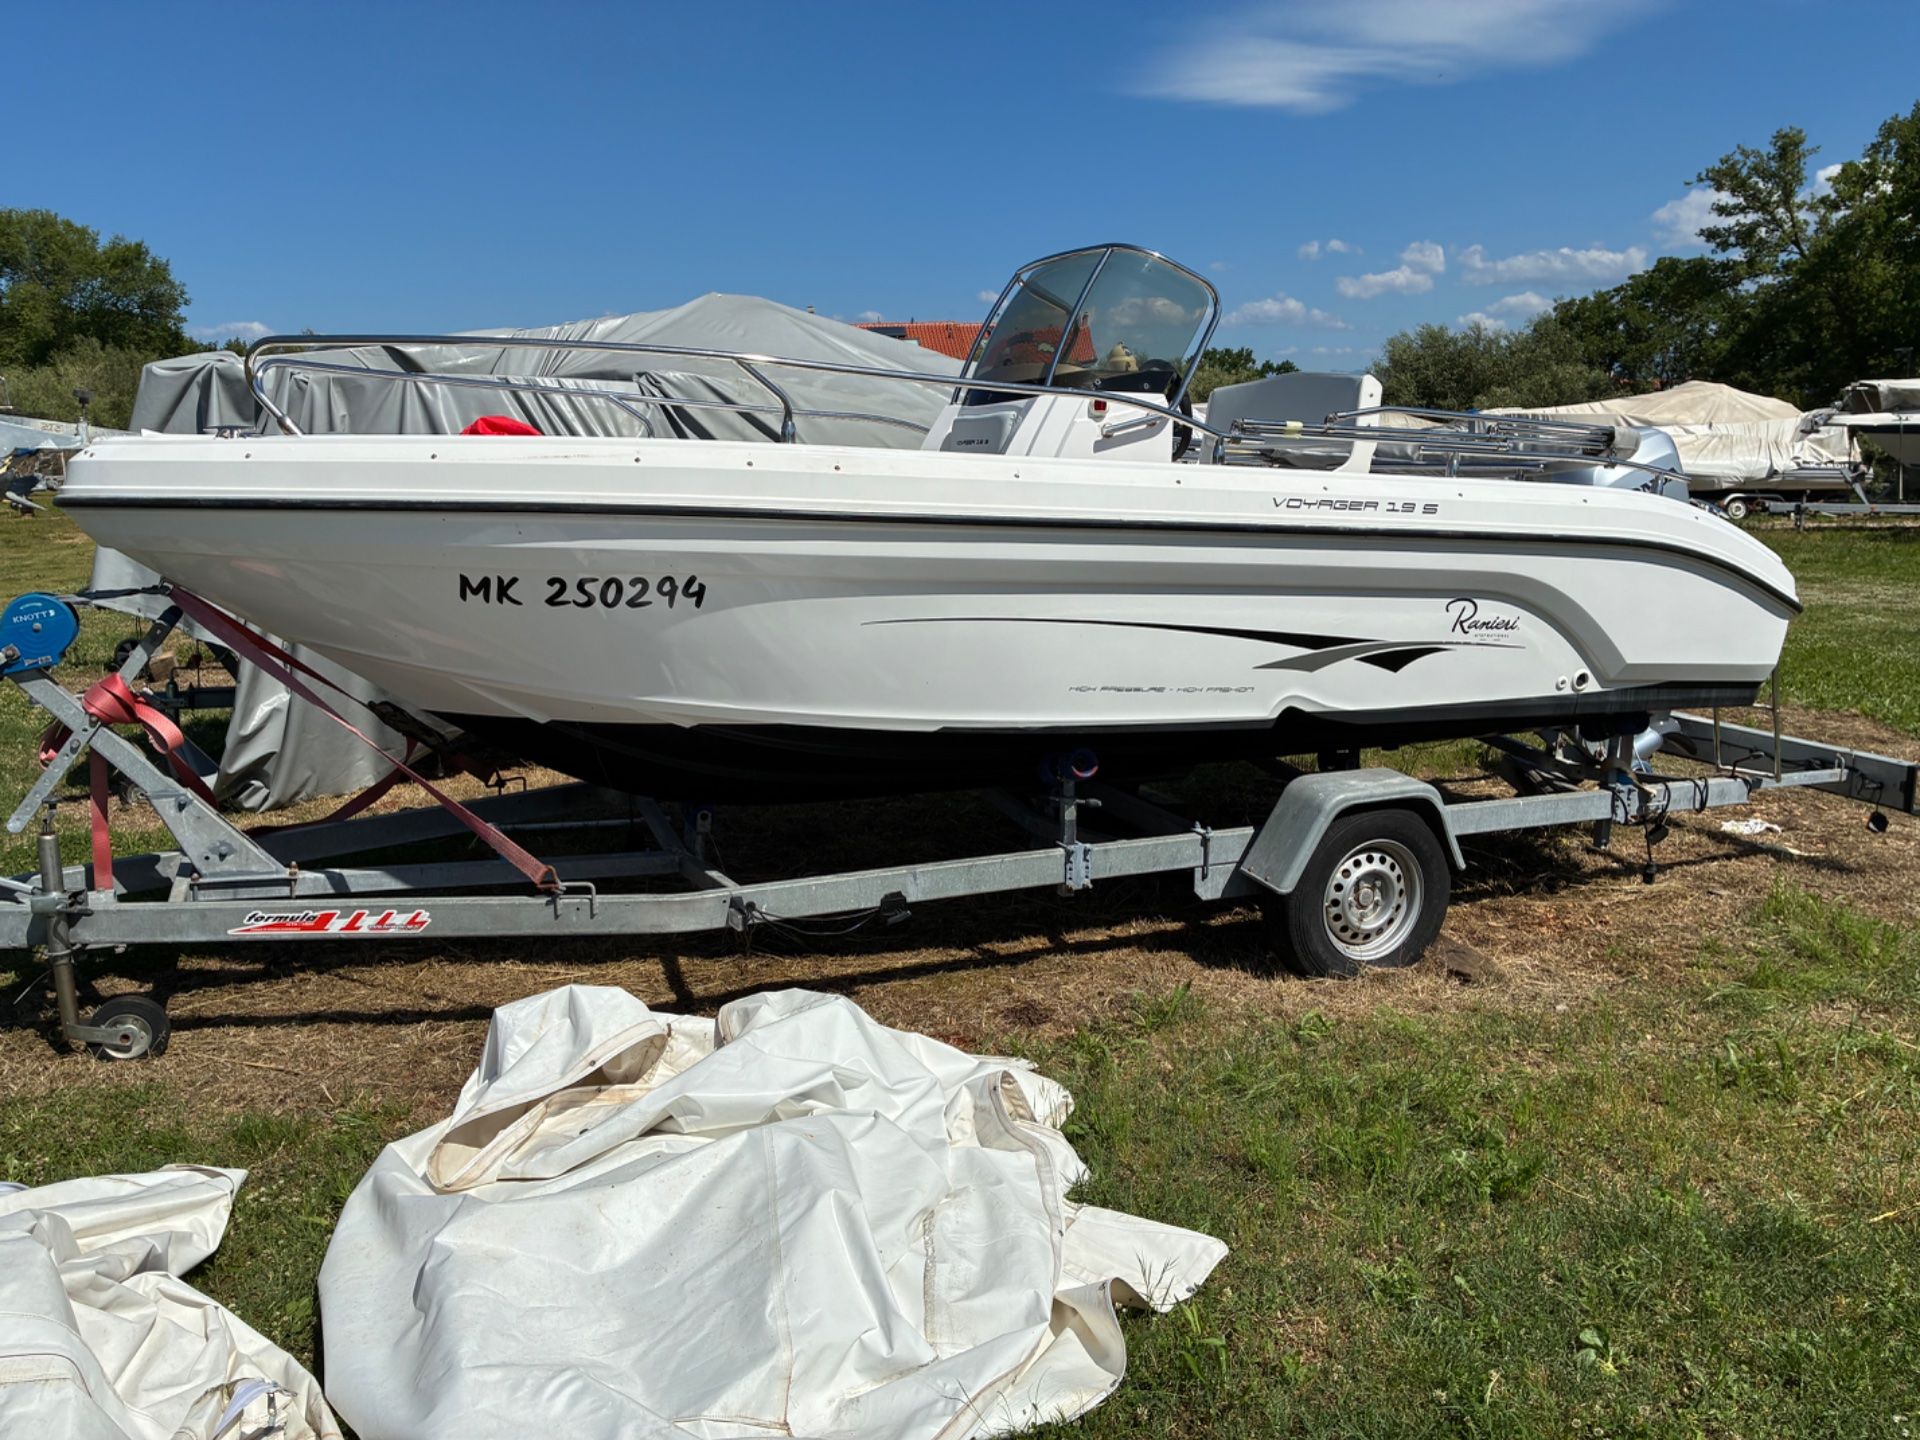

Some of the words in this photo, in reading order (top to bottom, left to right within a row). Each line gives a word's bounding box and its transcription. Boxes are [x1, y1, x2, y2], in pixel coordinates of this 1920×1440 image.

[1272, 497, 1379, 512] VOYAGER
[1385, 501, 1417, 514] 19
[459, 573, 523, 606] MK
[544, 574, 707, 609] 250294
[12, 609, 48, 624] KNOTT
[1445, 597, 1520, 635] Ranieri
[246, 911, 318, 923] formula
